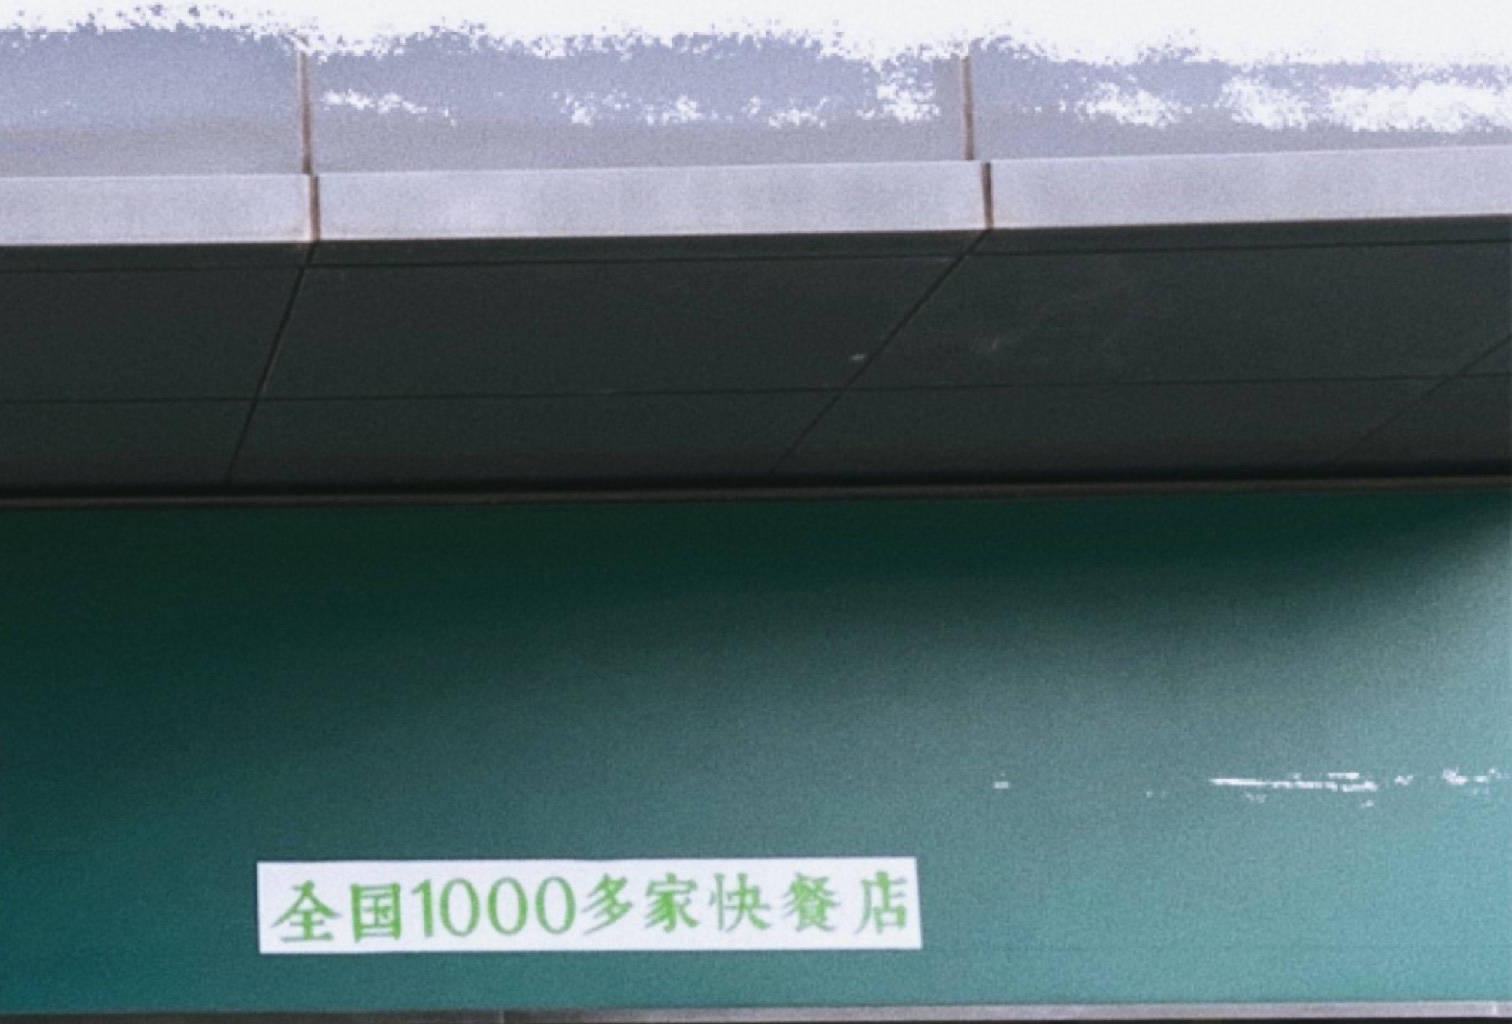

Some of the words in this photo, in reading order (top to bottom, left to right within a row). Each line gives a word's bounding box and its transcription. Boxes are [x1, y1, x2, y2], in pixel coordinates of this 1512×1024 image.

[271, 870, 909, 944] 全国1000多家快餐店
